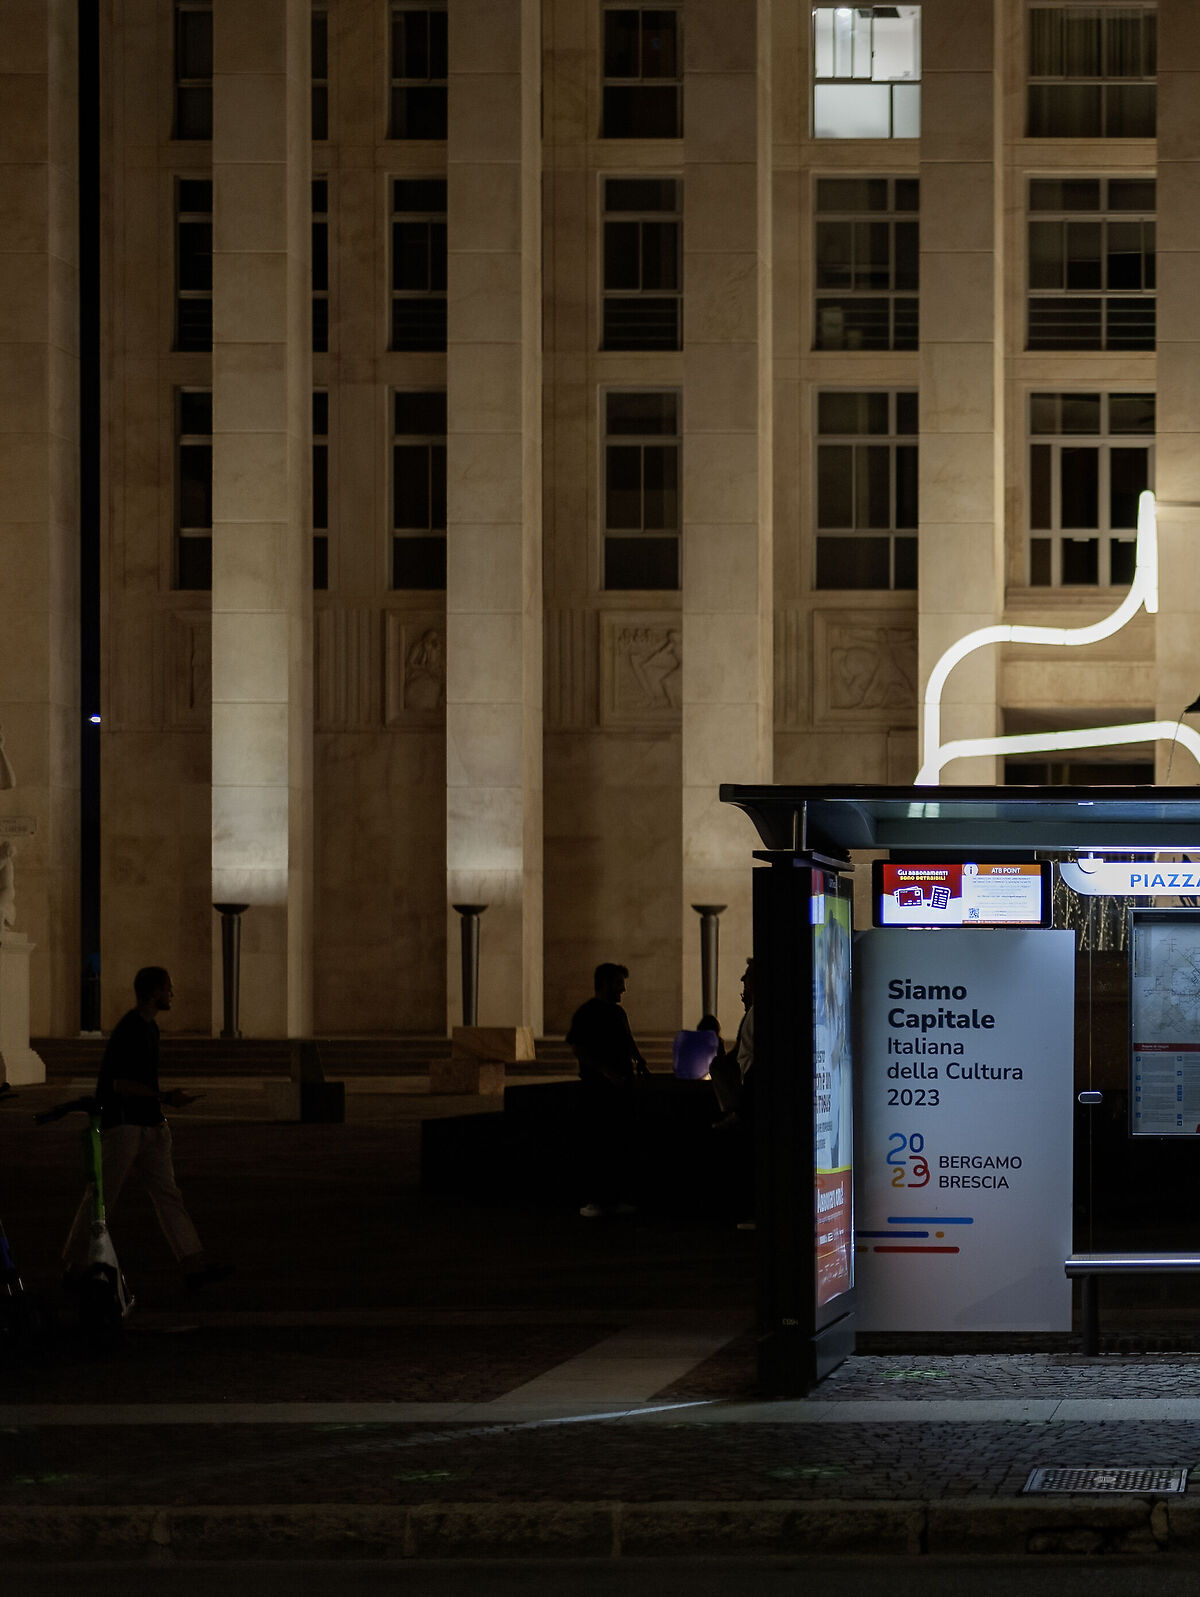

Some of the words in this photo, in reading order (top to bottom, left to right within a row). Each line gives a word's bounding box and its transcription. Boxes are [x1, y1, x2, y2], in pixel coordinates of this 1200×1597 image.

[888, 979, 967, 1000] Siamo
[888, 1008, 995, 1033] Capitale
[887, 1037, 964, 1055] Italiana
[887, 1062, 938, 1080] della
[946, 1062, 1023, 1080] Cultura
[887, 1089, 940, 1106] 2023
[939, 1156, 1022, 1169] BERGAMO
[939, 1176, 1009, 1189] BRESCIA
